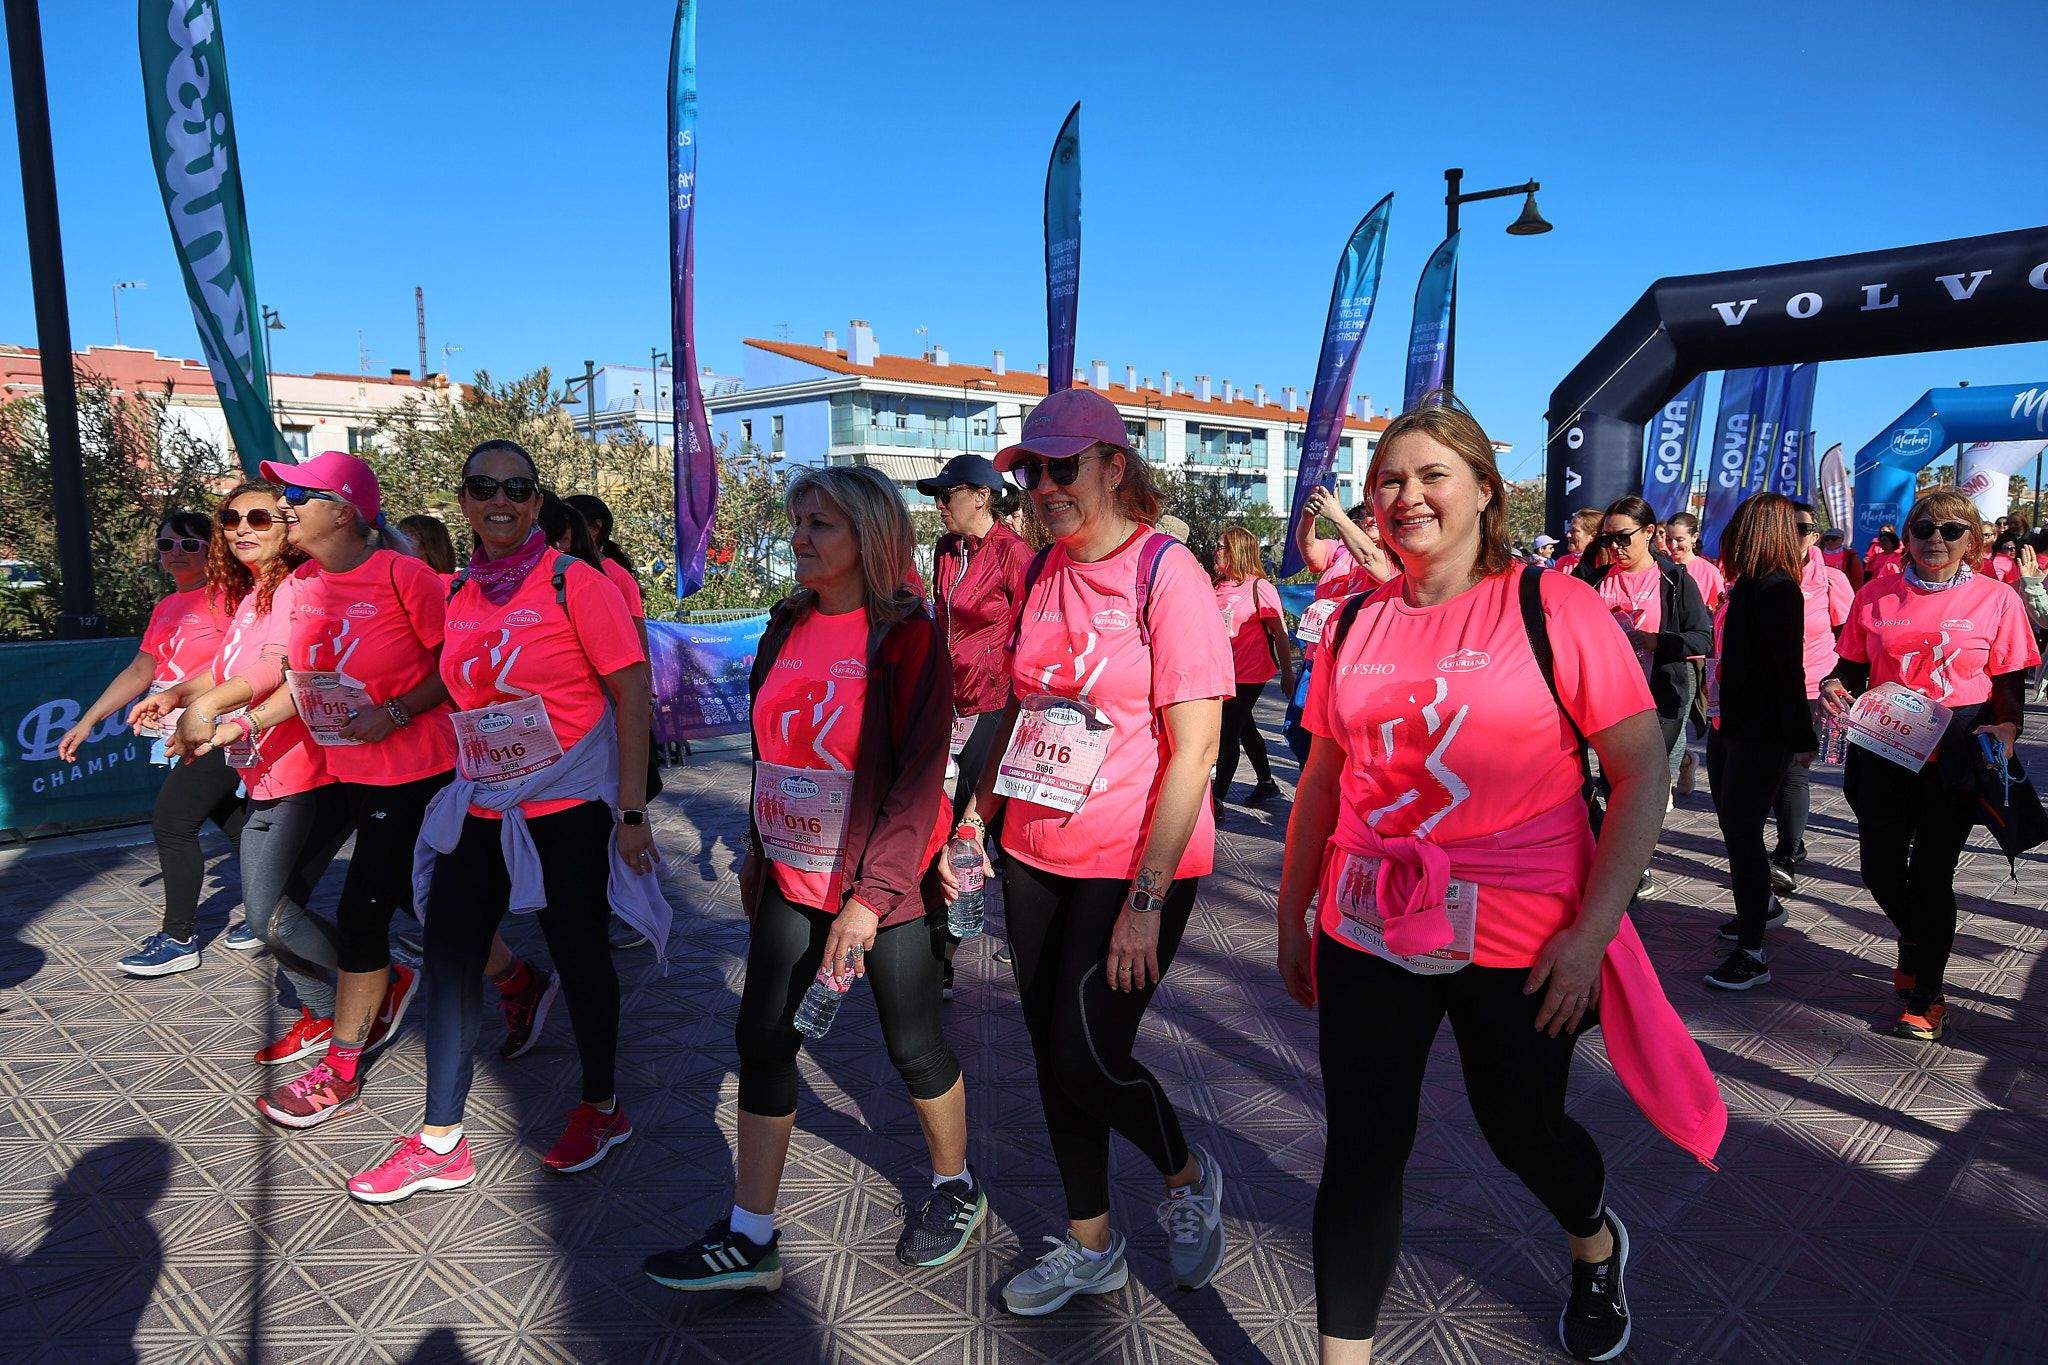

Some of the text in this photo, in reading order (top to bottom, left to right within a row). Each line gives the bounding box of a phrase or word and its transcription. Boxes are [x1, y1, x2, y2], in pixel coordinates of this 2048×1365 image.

[1655, 400, 1688, 484] GOYA
[1719, 413, 1749, 488] GOYA
[1779, 430, 1798, 496] GOYA
[506, 614, 540, 625] ASTURIANA
[1342, 663, 1395, 676] OYSHO
[1440, 658, 1487, 670] ASTURIANA
[324, 702, 349, 715] 016
[1046, 708, 1078, 723] ASTURIANA
[480, 719, 511, 730] ASTURIANA
[1880, 715, 1912, 736] 016
[490, 742, 526, 762] 016
[1034, 741, 1071, 764] 016
[32, 742, 136, 793] CHAMPÚ
[529, 759, 553, 774] VALENCIA
[1009, 769, 1026, 778] CARRERA
[1036, 764, 1053, 774] 8696
[1005, 780, 1080, 807] OYSHO Santand
[785, 814, 822, 834] 016
[1410, 958, 1454, 971] Santander
